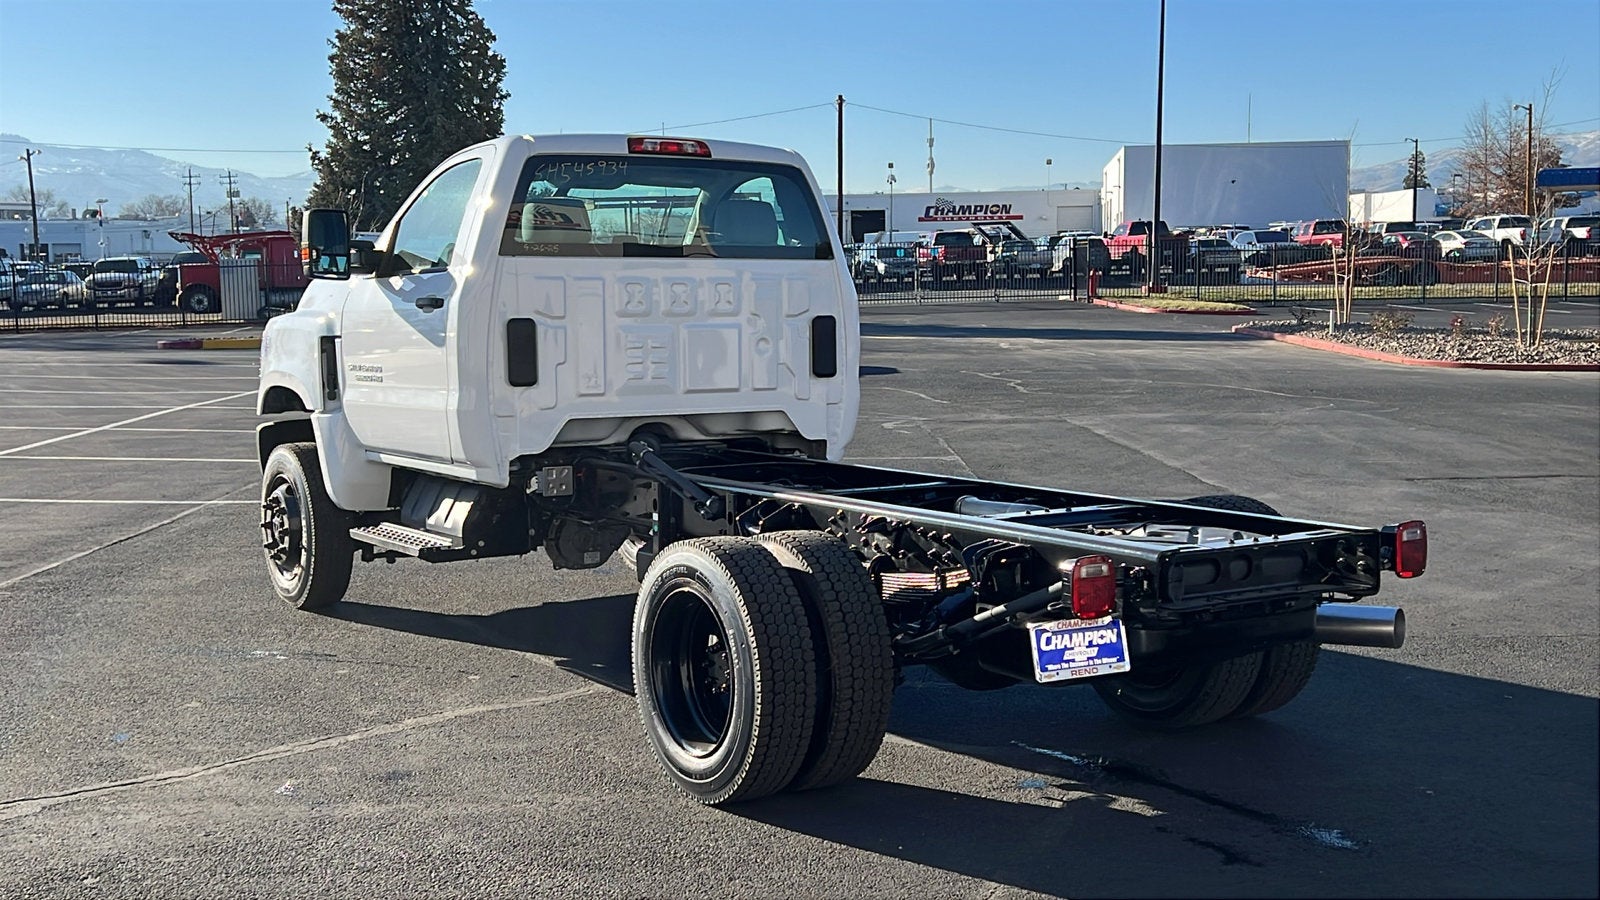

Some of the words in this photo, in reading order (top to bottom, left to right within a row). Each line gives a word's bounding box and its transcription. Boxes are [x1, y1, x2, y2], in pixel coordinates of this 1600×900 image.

[924, 204, 1012, 218] CHAMPION
[1056, 619, 1099, 629] CHAMPION
[1040, 629, 1117, 651] CHAMPION
[1070, 667, 1099, 677] RENO
